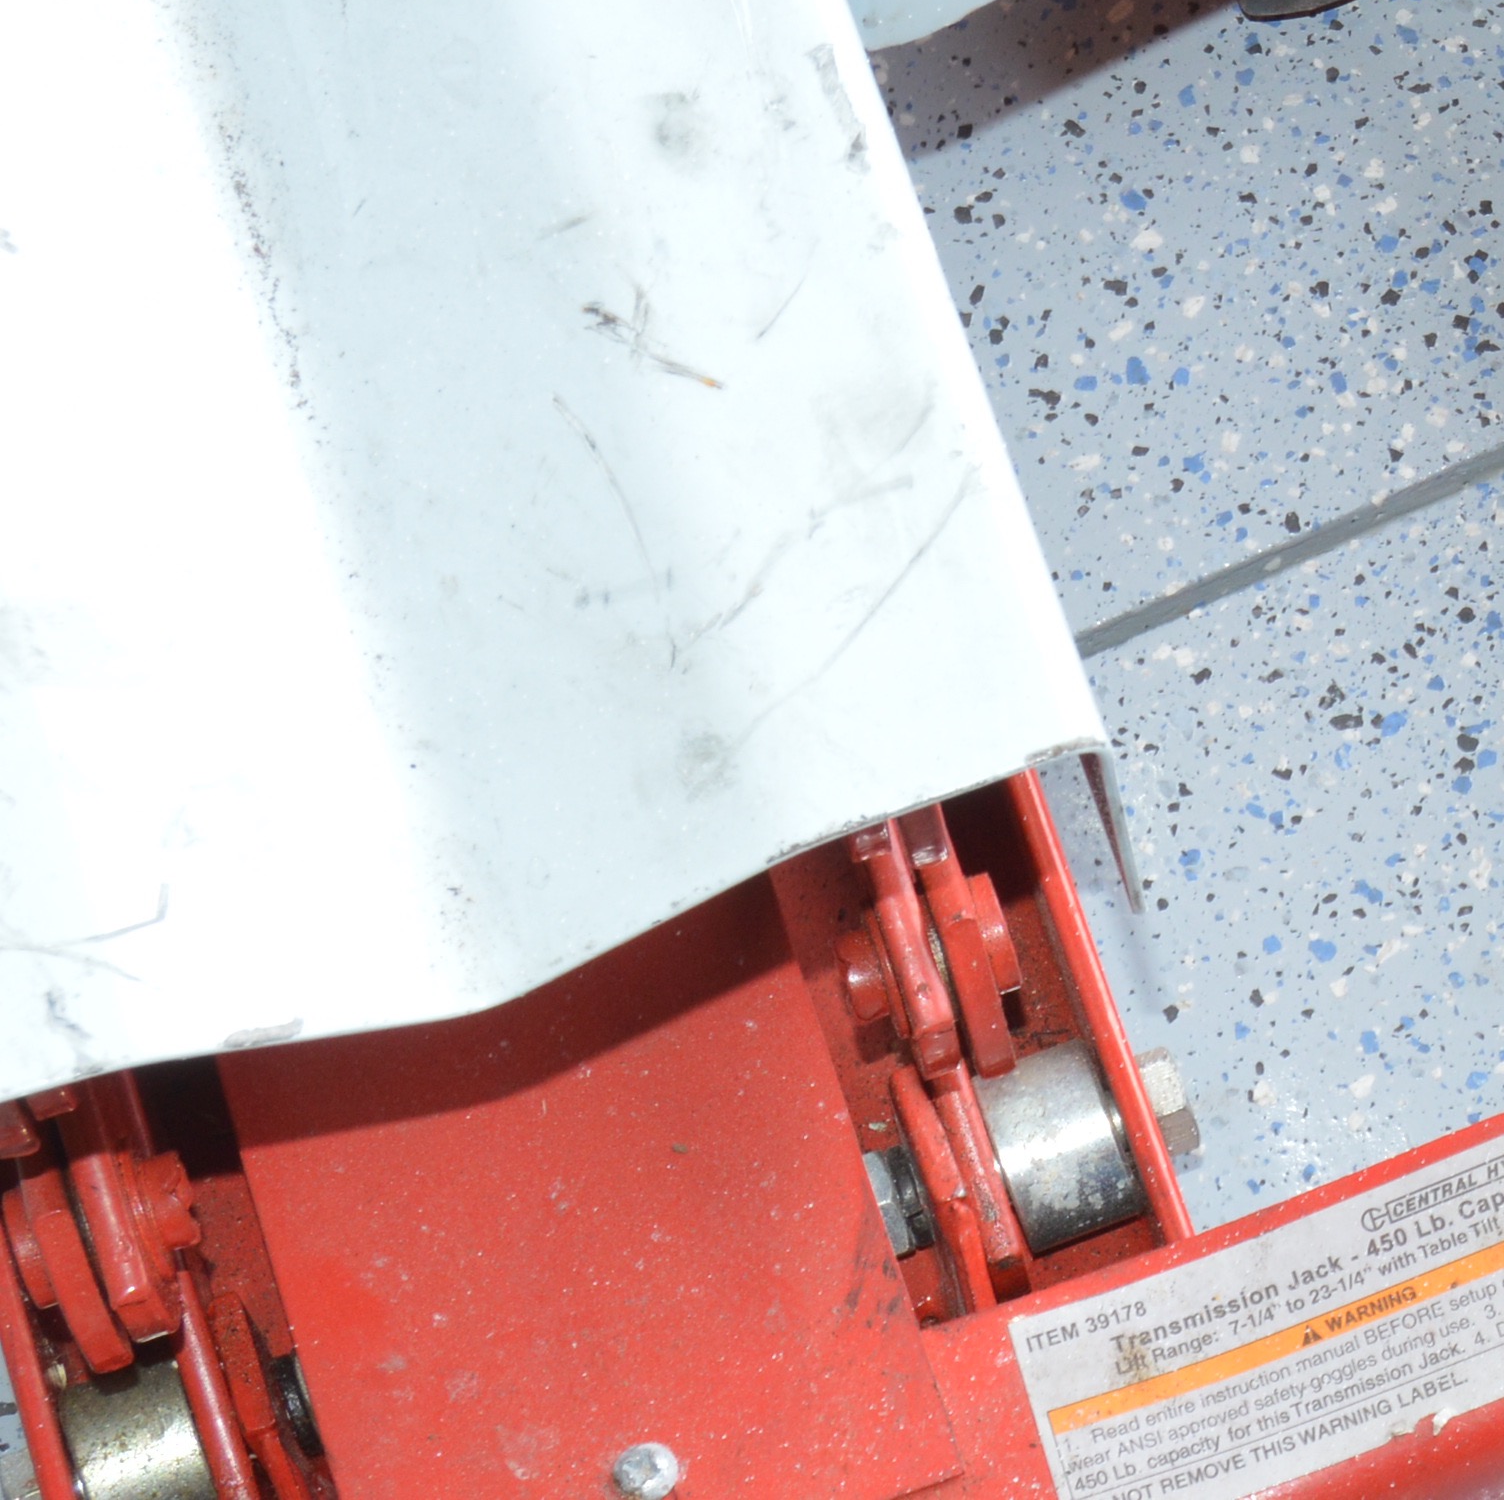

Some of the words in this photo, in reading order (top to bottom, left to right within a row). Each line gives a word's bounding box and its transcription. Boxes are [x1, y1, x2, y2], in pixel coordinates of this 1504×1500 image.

[1389, 1172, 1478, 1218] CENTRAL
[1024, 1319, 1080, 1355] ITEM
[1083, 1297, 1148, 1336] 39178
[1110, 1276, 1280, 1358] Transmission
[1283, 1252, 1345, 1292] Jack
[1363, 1226, 1409, 1259] 450
[1413, 1208, 1454, 1238] Lb.
[1114, 1351, 1148, 1377] Lift
[1151, 1326, 1220, 1369] Range:
[1285, 1294, 1306, 1314] to
[1375, 1249, 1417, 1277] with
[1417, 1228, 1469, 1260] Table
[1468, 1215, 1501, 1240] Tilt
[1324, 1284, 1418, 1333] WARNING
[1066, 1445, 1113, 1476] wear
[1114, 1428, 1164, 1460] ANSI
[1166, 1399, 1251, 1445] approved
[1308, 1351, 1379, 1394] goggles
[1378, 1328, 1437, 1364] during
[1482, 1301, 1502, 1321] 3.
[1072, 1468, 1109, 1495] 450
[1145, 1430, 1223, 1476] capacity
[1225, 1420, 1254, 1443] for
[1254, 1406, 1291, 1433] this
[1289, 1359, 1414, 1420] Transmission
[1415, 1337, 1467, 1371] Jack.
[1471, 1328, 1491, 1348] 4.
[1089, 1413, 1141, 1446] Read
[1143, 1395, 1197, 1429] entire
[1198, 1360, 1292, 1410] instruction
[1293, 1334, 1361, 1373] manual
[1362, 1300, 1446, 1346] BEFORE
[1447, 1281, 1499, 1315] setup
[1159, 1449, 1247, 1498] REMOVE
[1249, 1433, 1297, 1465] THIS
[1298, 1397, 1393, 1446] WARNING
[1395, 1367, 1469, 1408] LABEL.
